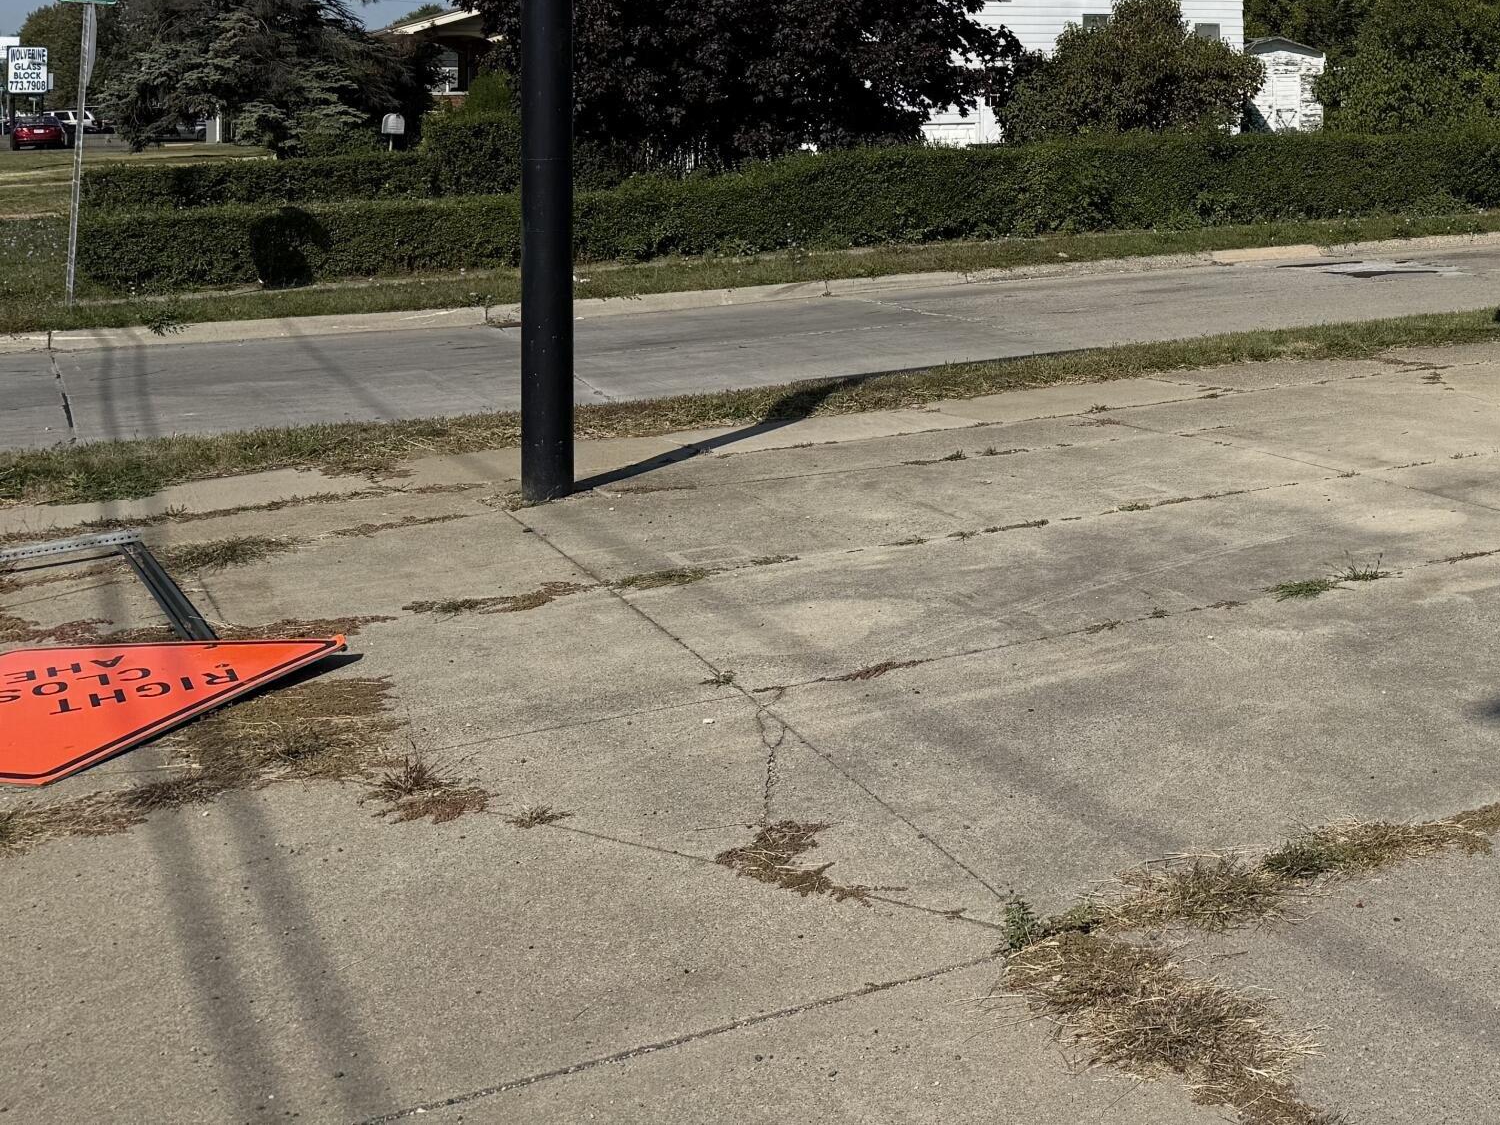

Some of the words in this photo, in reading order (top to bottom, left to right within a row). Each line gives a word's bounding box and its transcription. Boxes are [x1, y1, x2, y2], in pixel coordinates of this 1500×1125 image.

[10, 48, 46, 63] WOLVERINE
[14, 63, 42, 71] GLASS
[9, 80, 46, 91] 773.7908
[49, 668, 239, 715] RIGHT
